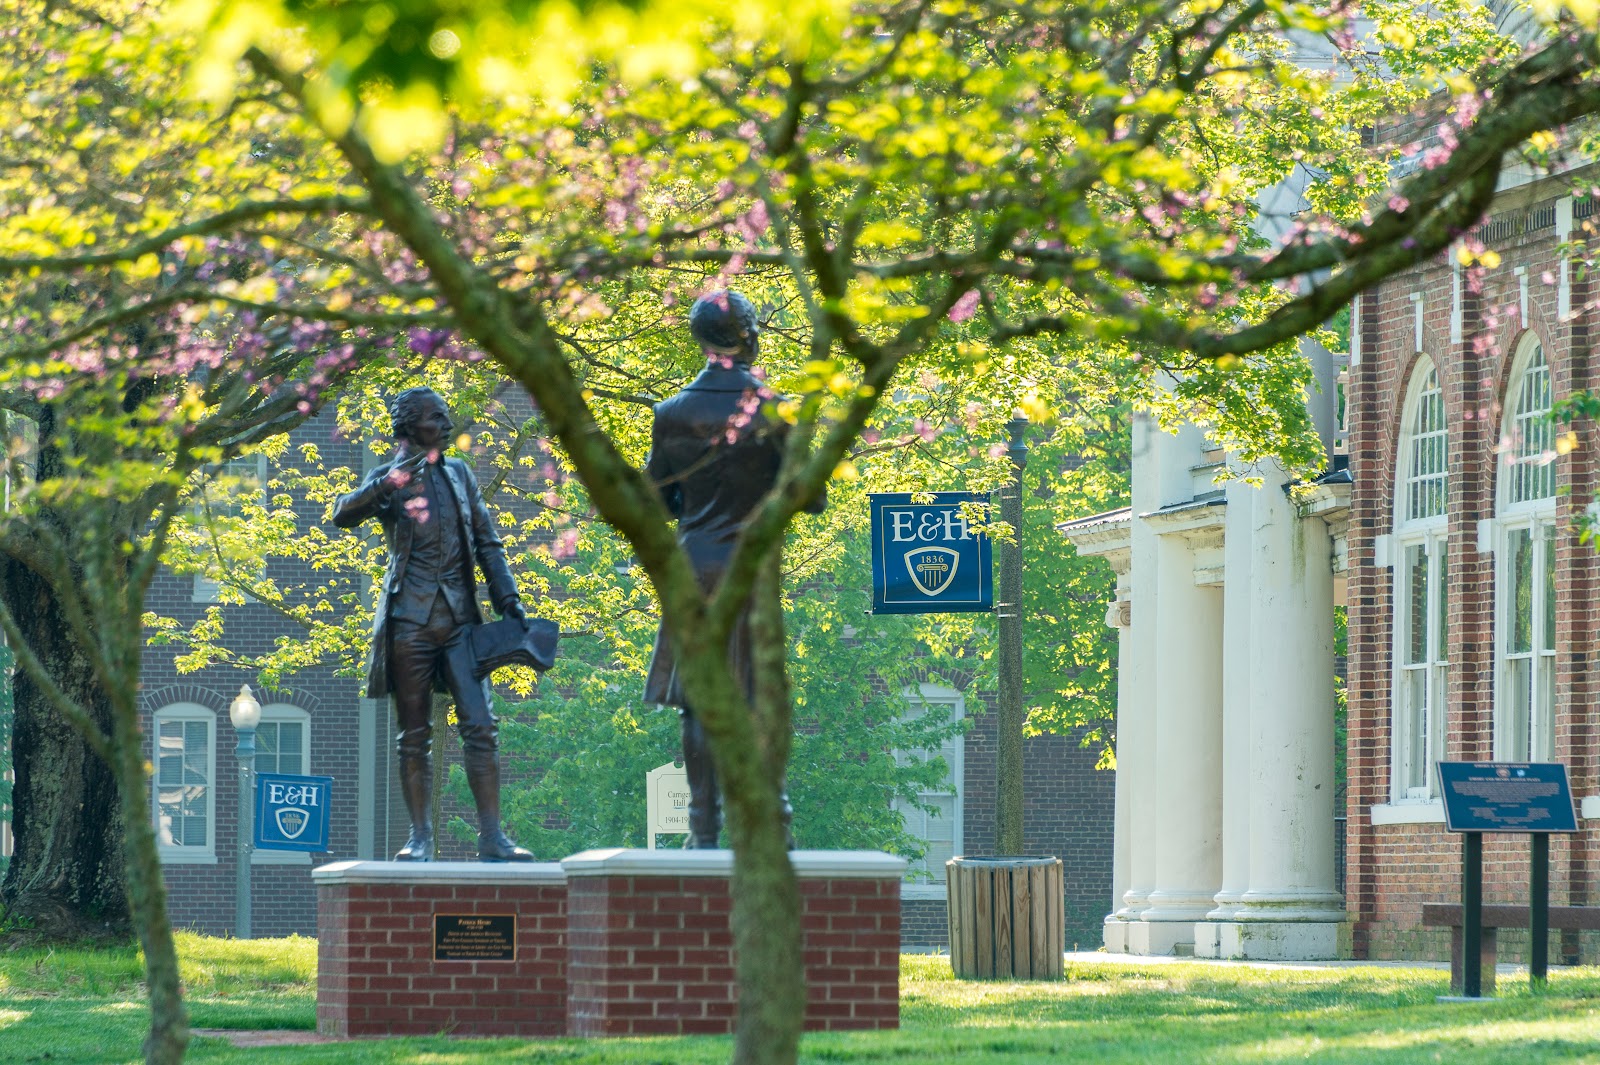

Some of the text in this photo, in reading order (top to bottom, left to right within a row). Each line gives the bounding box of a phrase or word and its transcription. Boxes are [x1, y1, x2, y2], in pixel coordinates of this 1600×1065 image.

[890, 510, 972, 542] E&H
[921, 555, 944, 563] 1836
[268, 783, 319, 807] E&H
[673, 799, 686, 807] Hall
